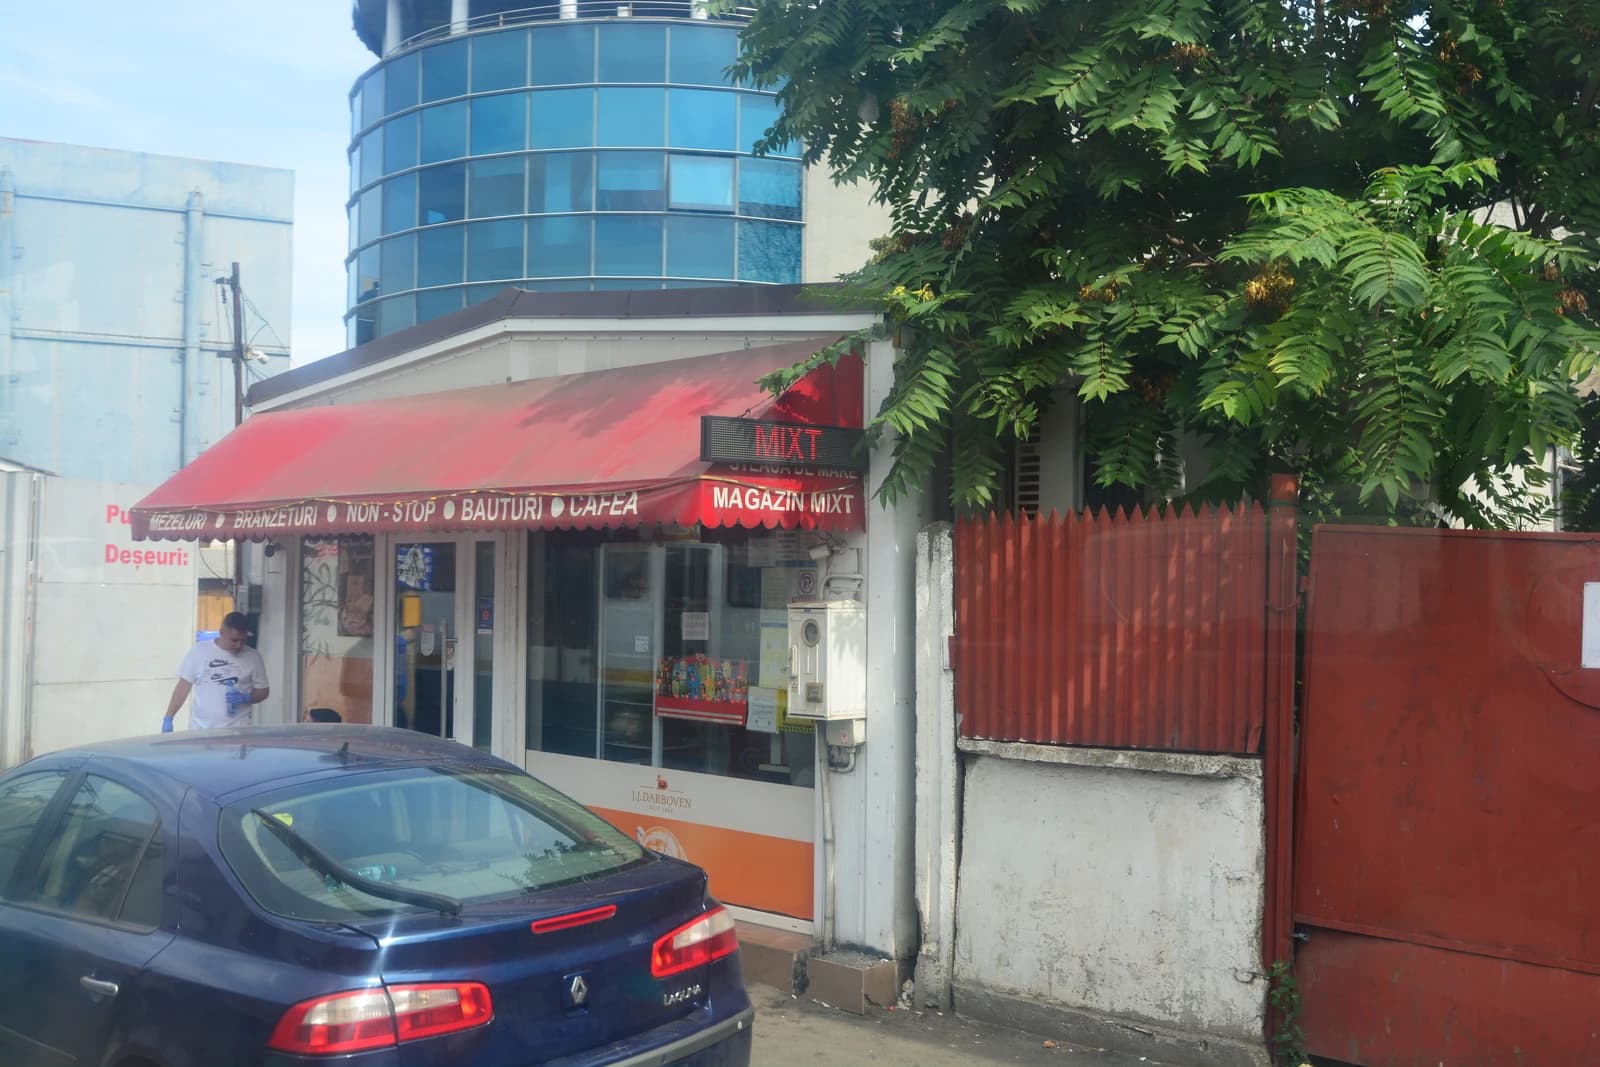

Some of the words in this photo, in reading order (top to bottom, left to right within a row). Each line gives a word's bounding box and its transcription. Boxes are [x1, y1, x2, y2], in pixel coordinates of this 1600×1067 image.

[755, 424, 822, 460] MIXT
[149, 511, 207, 532] MEZELURI
[233, 506, 318, 529] BRANZETURI
[461, 497, 542, 521] BAUTURI
[569, 491, 639, 516] CAFEA
[713, 486, 804, 512] MAGAZIN
[810, 492, 854, 514] MIXT
